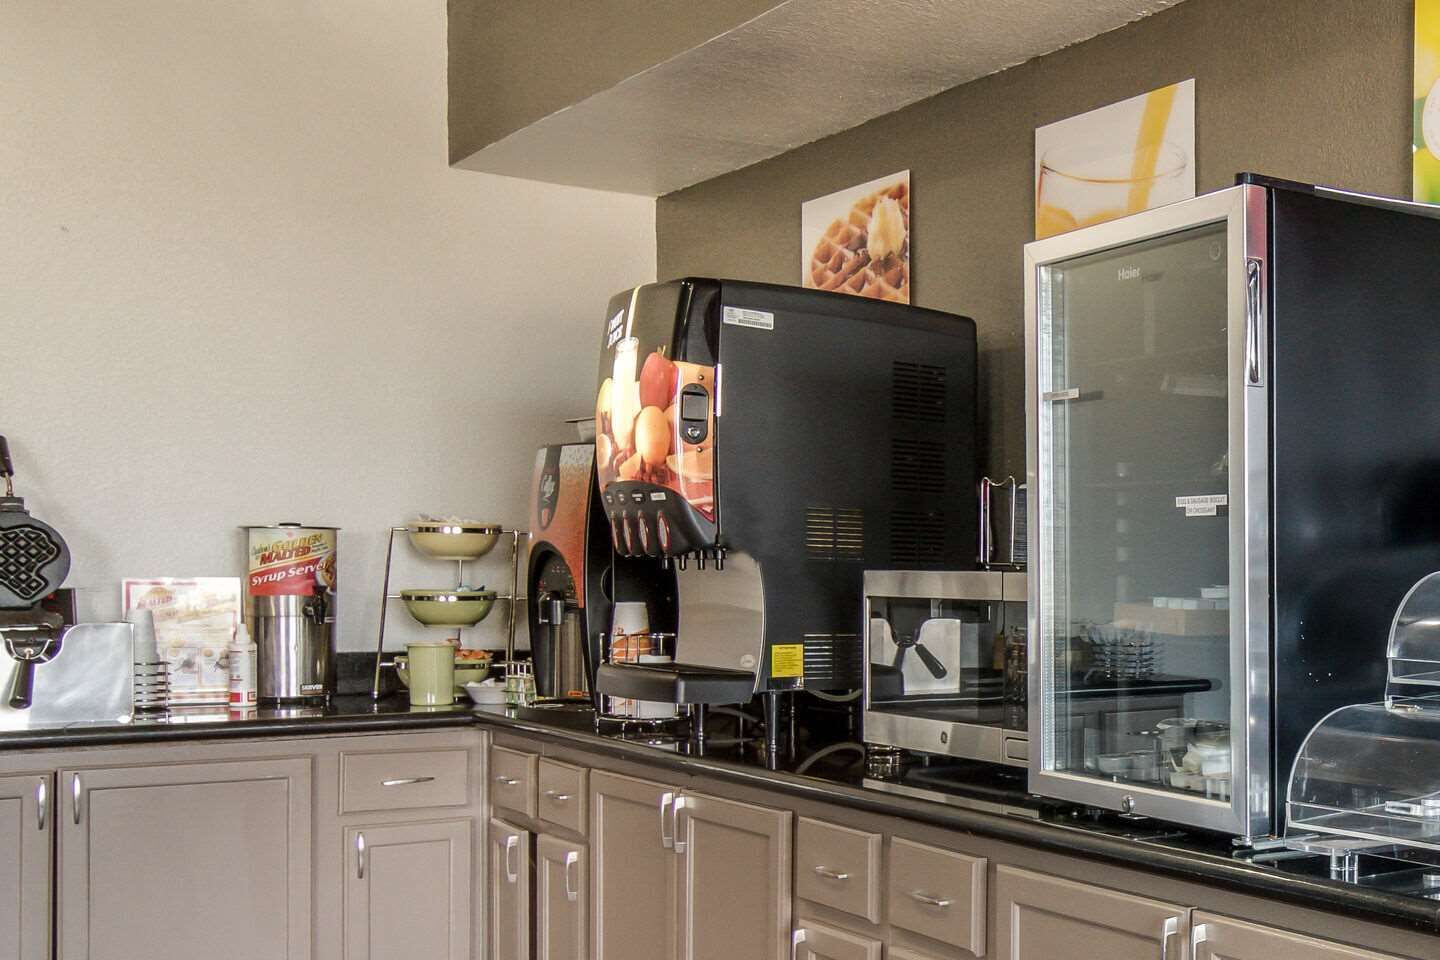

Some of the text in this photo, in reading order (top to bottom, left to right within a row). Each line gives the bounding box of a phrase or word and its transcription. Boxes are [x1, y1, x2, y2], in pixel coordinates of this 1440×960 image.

[1117, 265, 1140, 281] Haier
[259, 545, 311, 567] MALTED
[251, 561, 327, 586] Syrup Server
